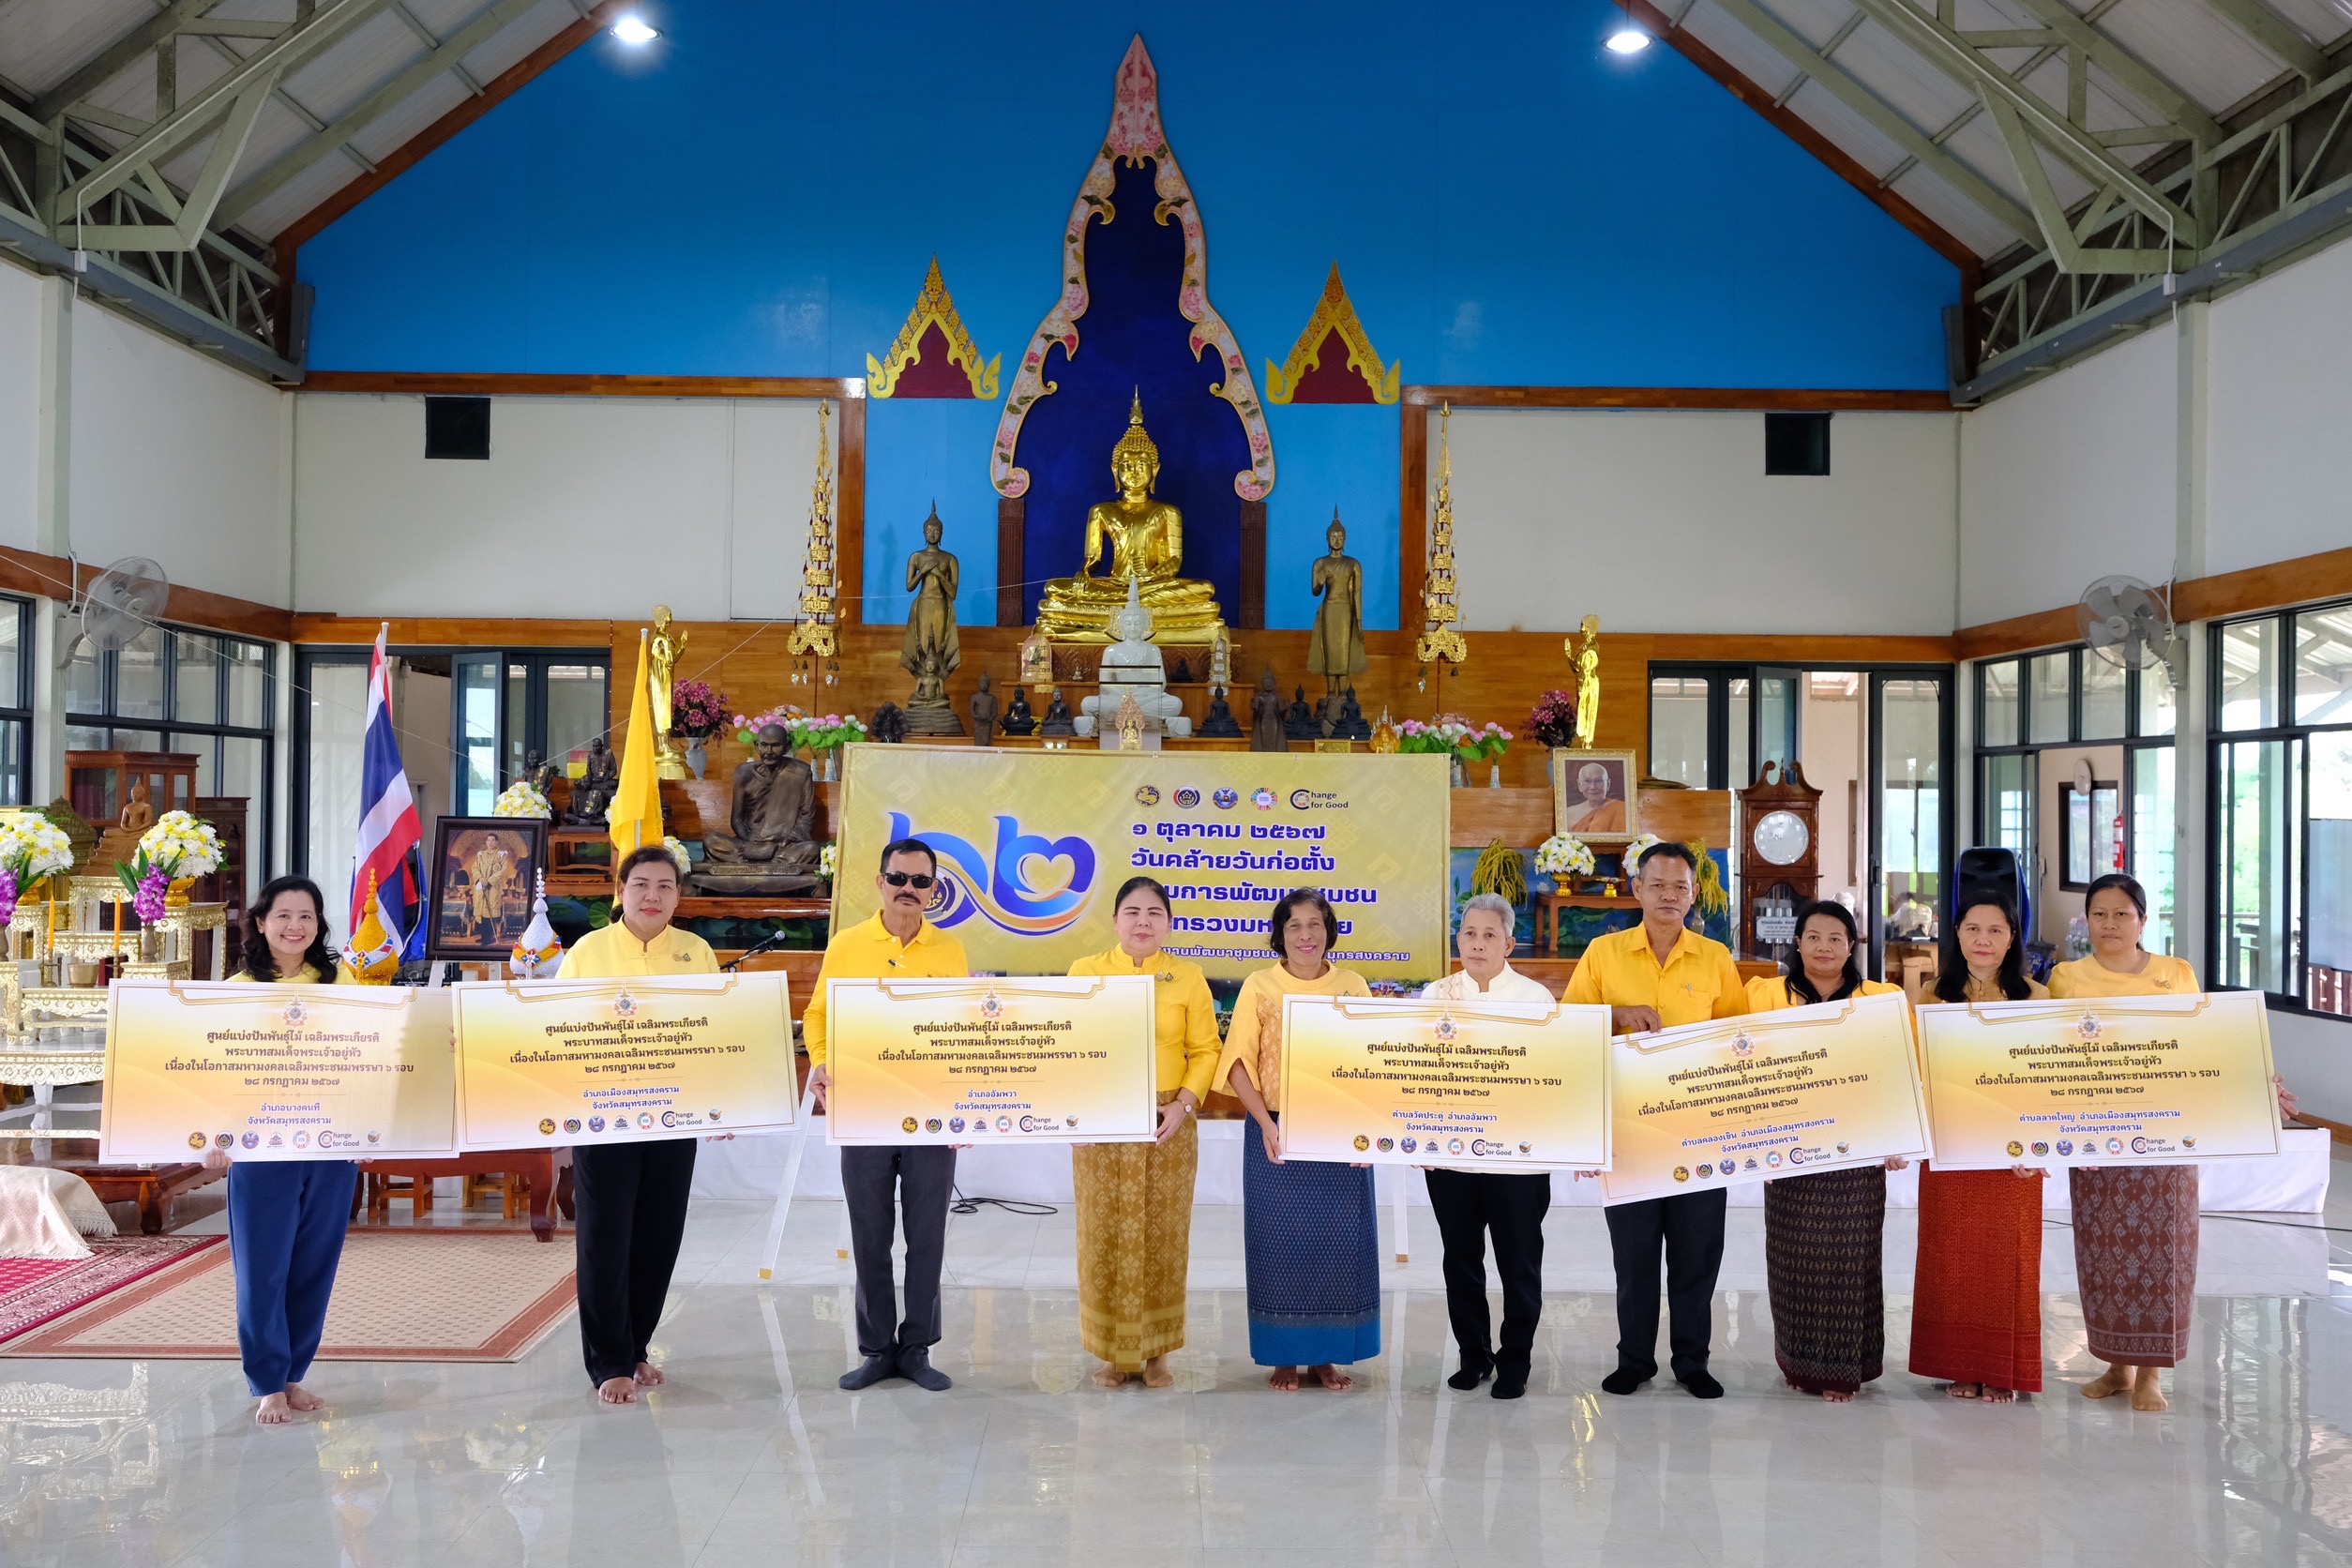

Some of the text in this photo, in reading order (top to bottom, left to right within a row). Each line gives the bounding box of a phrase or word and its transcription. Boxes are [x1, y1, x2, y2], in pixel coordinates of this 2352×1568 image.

[1325, 800, 1349, 808] Good
[1132, 822, 1326, 842] ๑ ตุลาคม ๒๕๖๗
[1131, 845, 1335, 871] วันคล้ายวันก่อตั้ง
[546, 1018, 708, 1035] ศูนย์แบ่งปันพันธุ์ไม้ เฉลิมพระเกียรติ
[913, 1020, 1072, 1033] ศูนย์แบ่งปันพันธุ์ไม้ เฉลิมพระเกียรติ
[207, 1029, 380, 1045] ศูนย์แบ่งปันพันธุ์ไม้ เฉลิมพระเกียรติ
[564, 1033, 692, 1049] พระบาทสมเด็จพระเจ้าอยู่หัว
[930, 1035, 1055, 1048] พระบาทสมเด็จพระเจ้าอยู่หัว
[225, 1046, 361, 1060] พระบาทสมเด็จพระเจ้าอยู่หัว
[510, 1045, 716, 1063] เนื่องในโอกาสมหามงคลเฉลิมพระชนมพรรษา
[727, 1045, 745, 1053] รอบ
[878, 1048, 1077, 1062] เนื่องในโอกาสมหามงคลเฉลิมพระชนมพรรษา
[1367, 1042, 1526, 1057] ศูนย์แบ่งปันพันธุ์ไม้ เฉลิมพระเกียรติ
[2009, 1040, 2178, 1059] ศูนย์แบ่งปันพันธุ์ไม้ เฉลิมพระเกียรติ
[165, 1057, 383, 1073] เนื่องในโอกาสมหามงคลเฉลิมพระชนมพรรษา
[395, 1063, 414, 1072] รอบ
[602, 1063, 645, 1074] กรกฎาคม
[648, 1061, 675, 1069] ๒๕๖๗
[966, 1065, 1007, 1075] กรกฎาคม
[1010, 1064, 1036, 1074] ๒๕๖๗
[1384, 1057, 1510, 1072] พระบาทสมเด็จพระเจ้าอยู่หัว
[1668, 1048, 1828, 1084] ศูนย์แบ่งปันพันธุ์ไม้ เฉลิมพระเกียรติ
[2028, 1056, 2162, 1071] พระบาทสมเด็จพระเจ้าอยู่หัว
[245, 1076, 339, 1087] ๒๘ กรกฎาคม ๒๕๖๗
[1332, 1066, 1531, 1085] เนื่องในโอกาสมหามงคลเฉลิมพระชนมพรรษา
[1543, 1078, 1561, 1086] รอบ
[1687, 1066, 1813, 1094] พระบาทสมเด็จพระเจ้าอยู่หัว
[1975, 1070, 2187, 1086] เนื่องในโอกาสมหามงคลเฉลิมพระชนมพรรษา
[2199, 1068, 2220, 1078] รอบ
[582, 1085, 679, 1100] อำเภอเมืองสมุทรสงคราม
[968, 1090, 1017, 1099] อำเภออัมพวา
[1418, 1086, 1461, 1096] กรกฎาคม
[1463, 1088, 1490, 1096] ๒๕๖๗
[1638, 1077, 1838, 1116] เนื่องในโอกาสมหามงคลเฉลิมพระชนมพรรษา
[1848, 1073, 1868, 1082] รอบ
[2068, 1086, 2113, 1097] กรกฎาคม
[2116, 1084, 2145, 1094] ๒๕๖๗
[261, 1103, 320, 1112] อำเภอบางคนที
[593, 1097, 672, 1110] จังหวัดสมุทรสงคราม
[954, 1101, 1032, 1112] จังหวัดสมุทรสงคราม
[1711, 1097, 1799, 1118] ๒๘ กรกฎาคม ๒๕๖๗
[249, 1115, 331, 1126] จังหวัดสมุทรสงคราม
[1393, 1109, 1497, 1122] ตำบลวัดประดู่ อำเภออัมพวา
[2019, 1108, 2180, 1123] ตำบลลาดใหญ่ อำเภอเมืองสมุทรสงคราม
[1406, 1122, 1484, 1134] จังหวัดสมุทรสงคราม
[1681, 1117, 1835, 1148] ตำบลคลองเขิน อำเภอเมืองสมุทรสงคราม
[2059, 1122, 2142, 1134] จังหวัดสมุทรสงคราม
[1721, 1135, 1799, 1153] จังหวัดสมุทรสงคราม
[1815, 1153, 1831, 1161] Good
